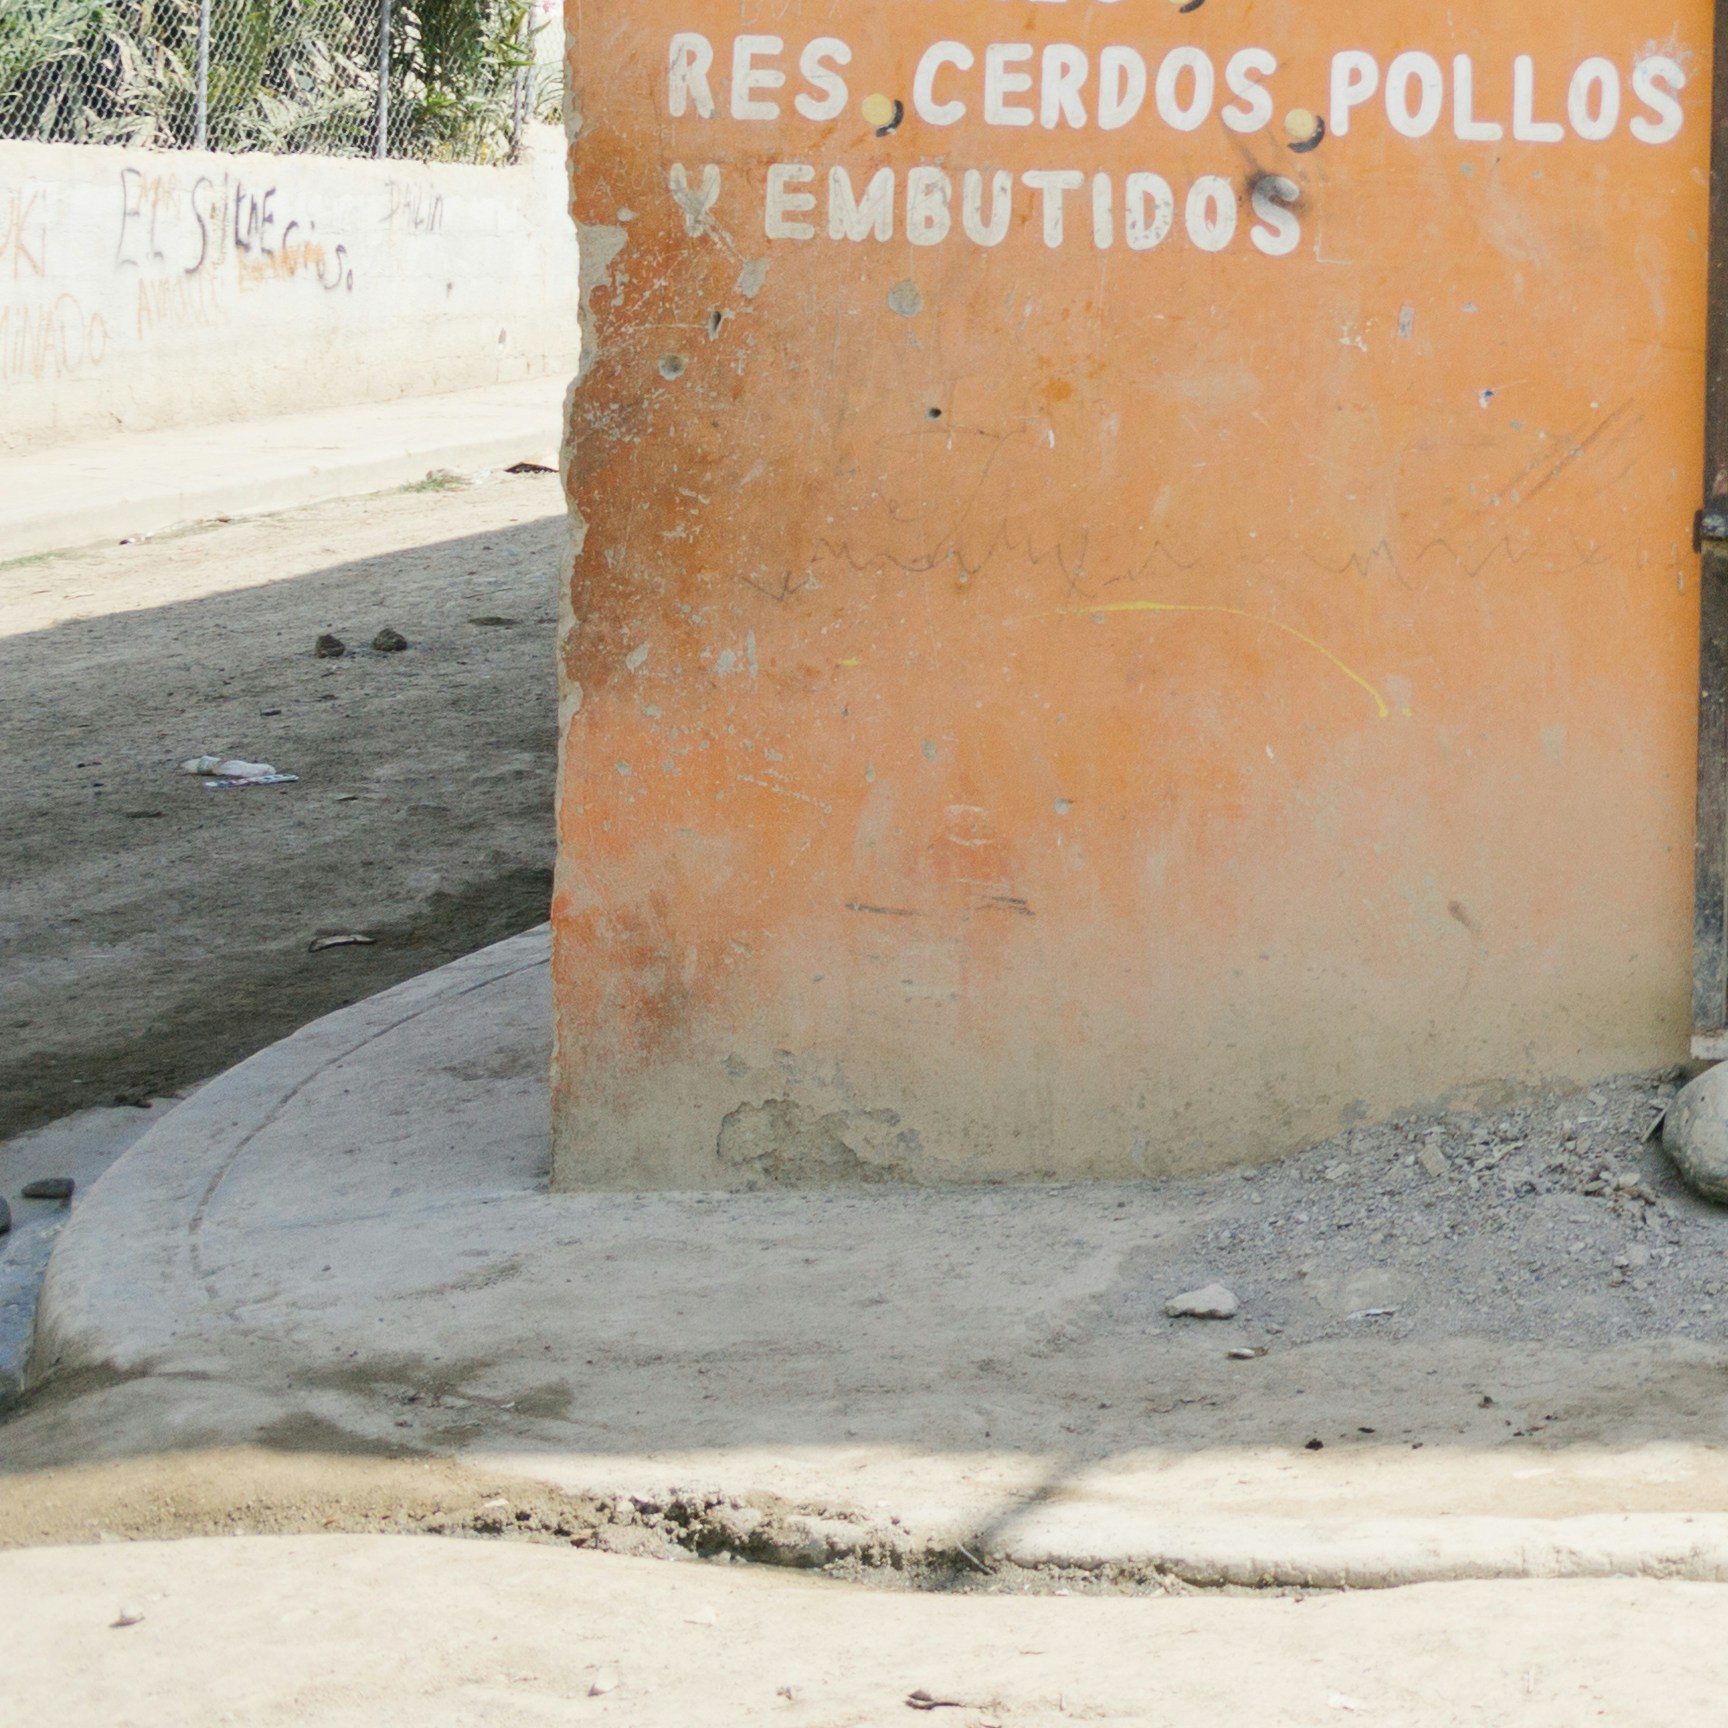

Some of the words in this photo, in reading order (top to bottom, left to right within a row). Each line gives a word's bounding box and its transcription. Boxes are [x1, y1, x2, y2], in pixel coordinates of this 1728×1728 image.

[1330, 50, 1687, 144] POLLOS
[669, 162, 722, 238] Y
[763, 163, 1302, 257] EMBUTIDOS
